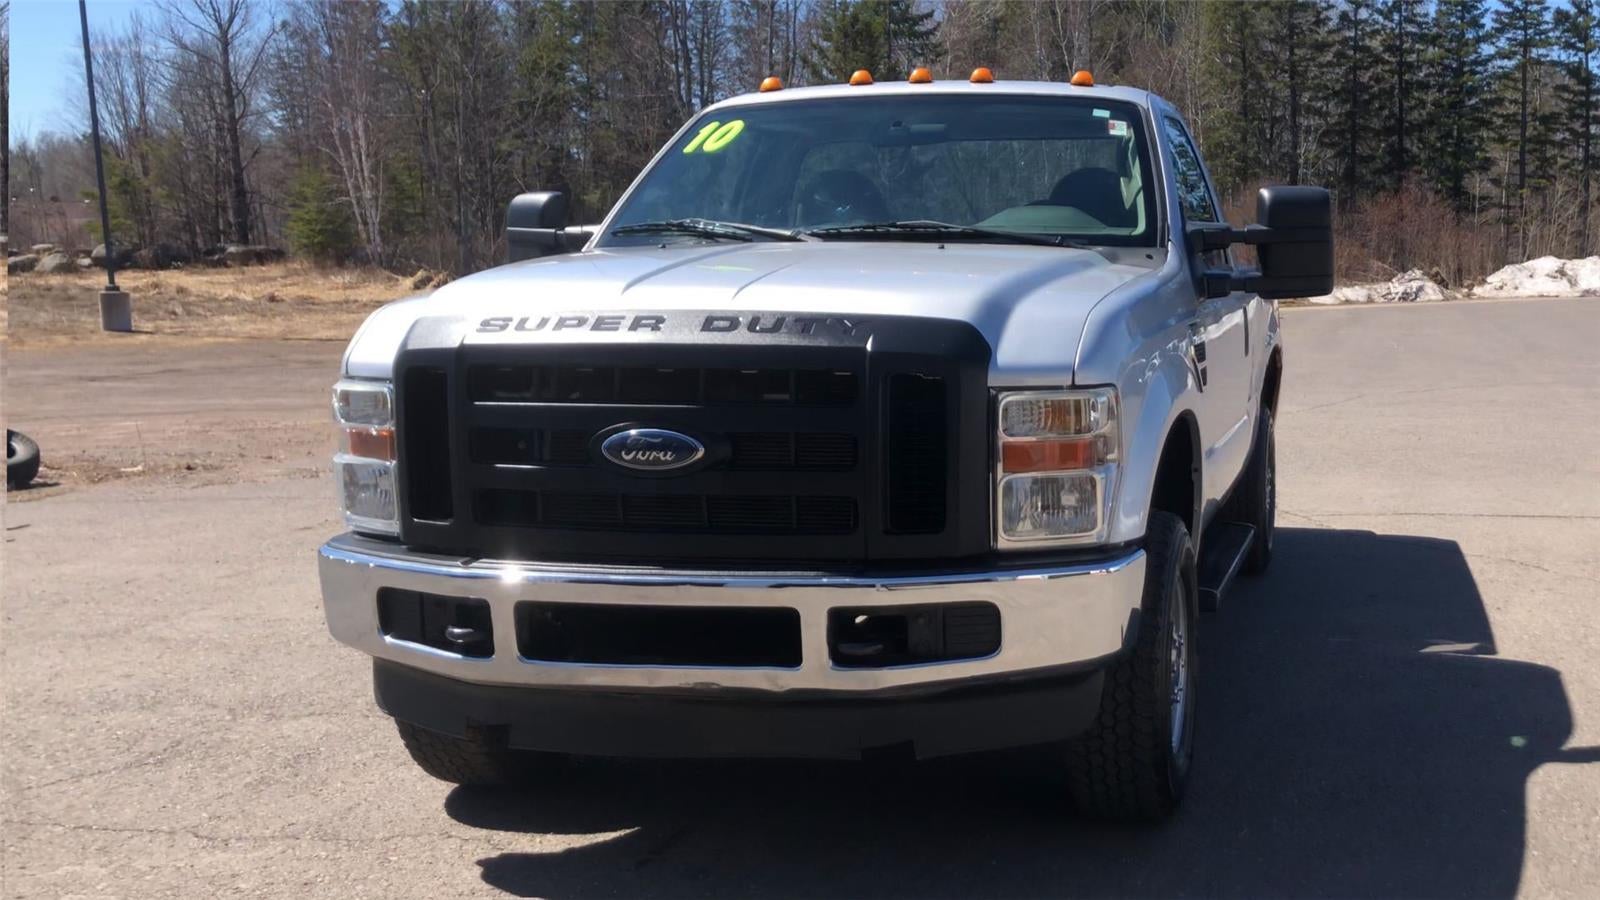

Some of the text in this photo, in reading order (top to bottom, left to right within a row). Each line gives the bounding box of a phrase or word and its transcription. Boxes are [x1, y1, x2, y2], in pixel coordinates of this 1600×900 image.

[682, 120, 745, 154] 10
[476, 315, 870, 336] SUPER DUTY
[620, 435, 678, 461] Ford
